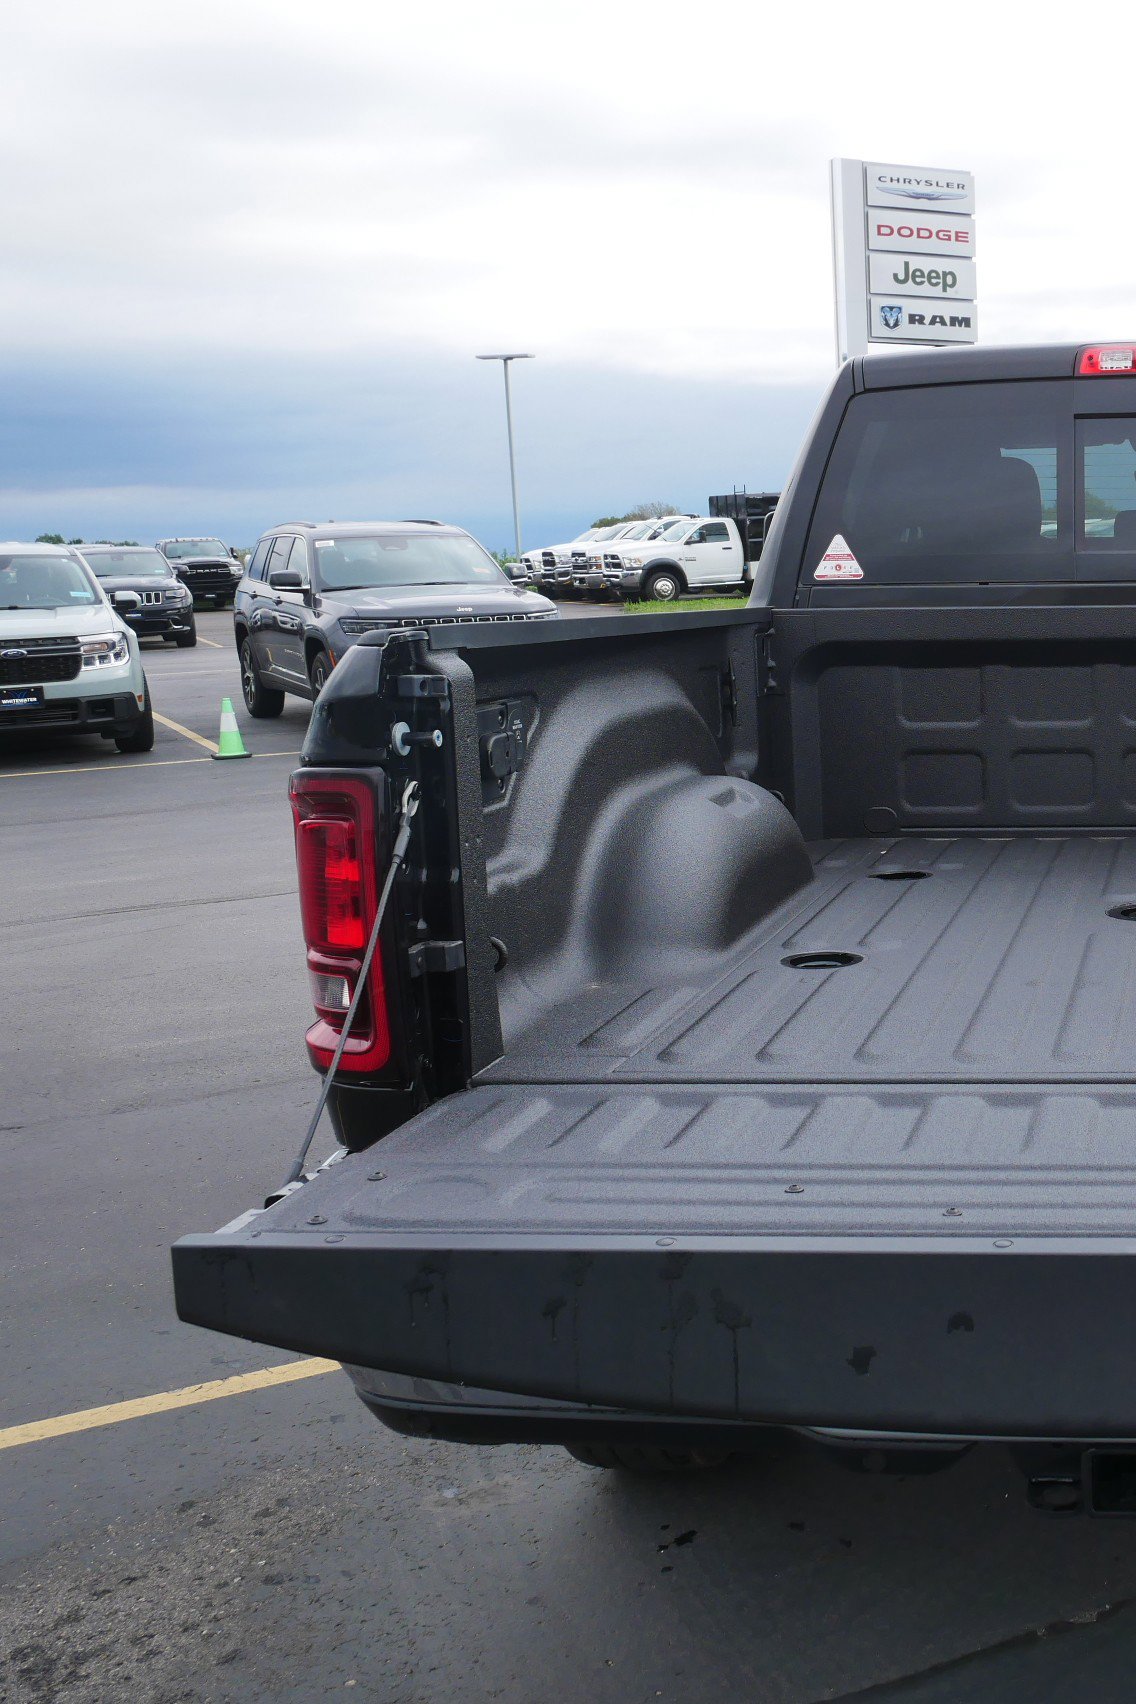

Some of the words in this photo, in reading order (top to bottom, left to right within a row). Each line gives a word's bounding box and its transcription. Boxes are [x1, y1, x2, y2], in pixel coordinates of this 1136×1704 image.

[878, 175, 966, 190] CHRYSLER
[876, 224, 970, 243] DODGE
[892, 260, 958, 293] Jeep
[907, 313, 972, 328] RAM
